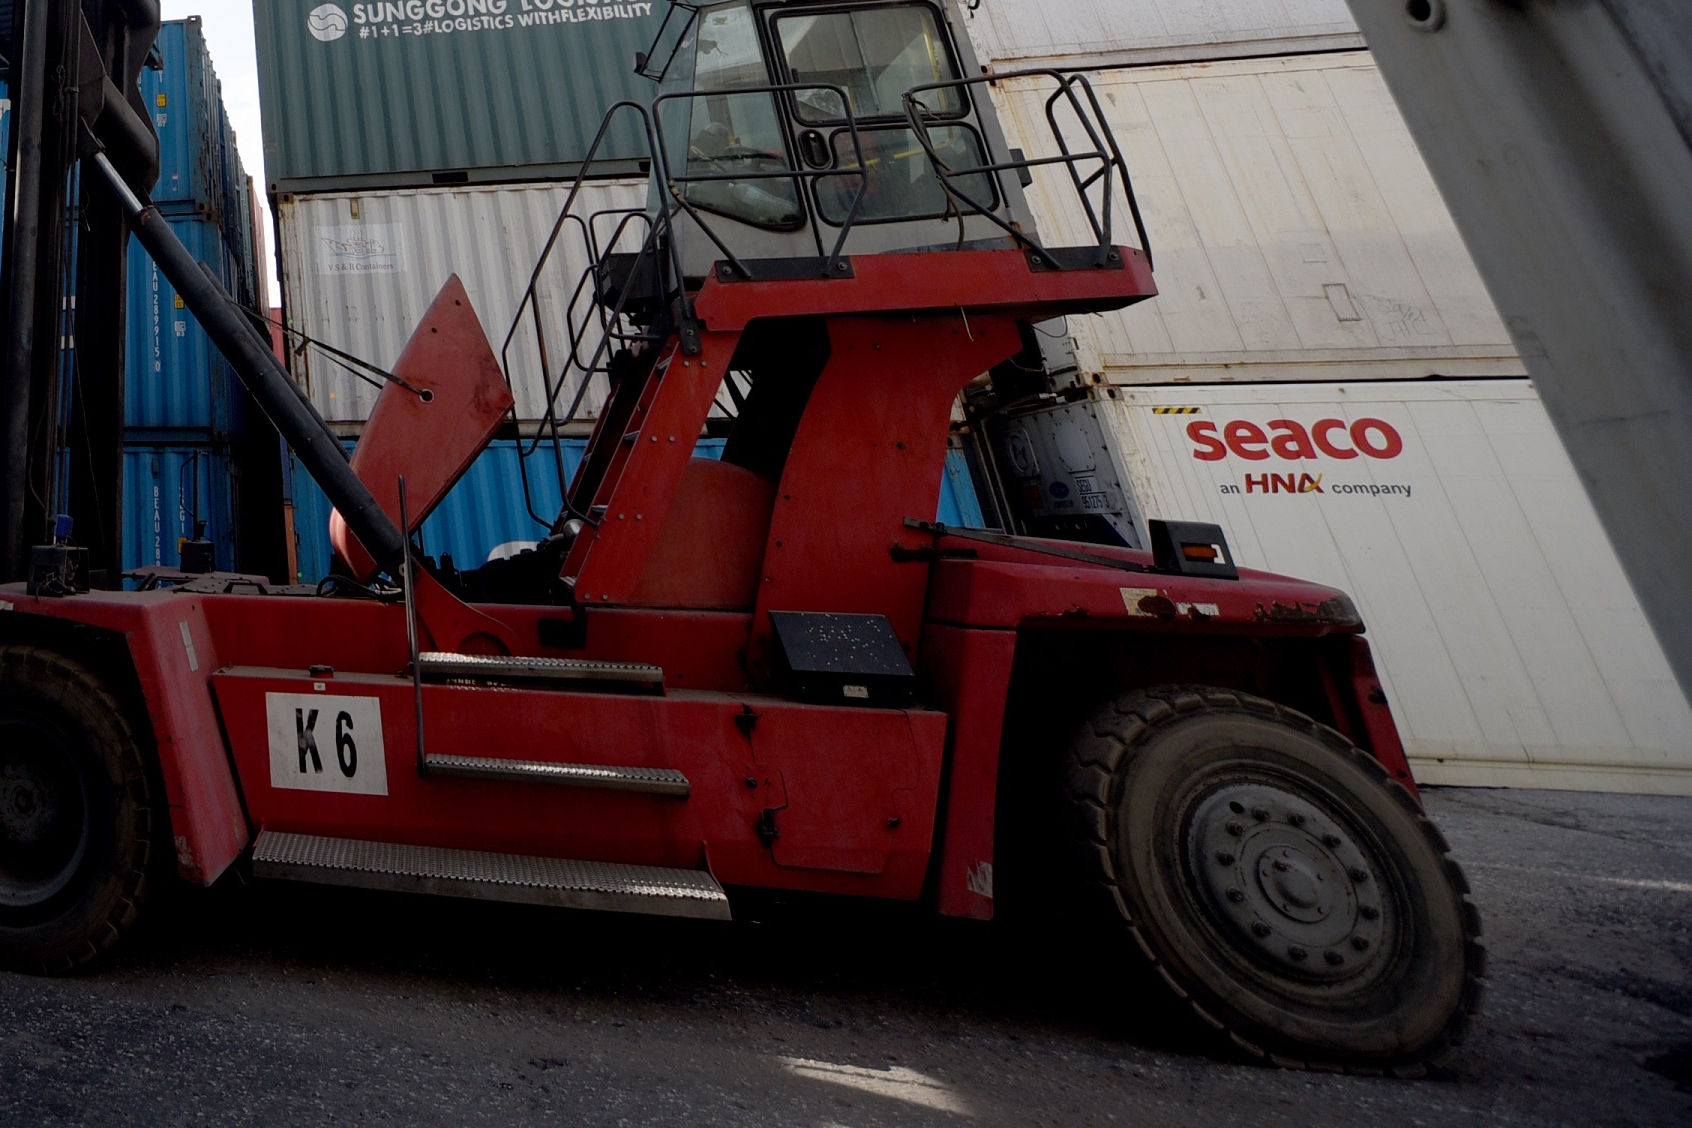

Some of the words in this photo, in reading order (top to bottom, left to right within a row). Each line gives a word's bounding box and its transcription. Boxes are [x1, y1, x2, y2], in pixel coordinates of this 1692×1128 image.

[359, 14, 514, 39] #1+1=3#LOGISTICS
[355, 261, 394, 271] Containers
[1185, 417, 1403, 462] seaco
[1219, 482, 1240, 495] an
[1244, 472, 1324, 494] HNA
[1331, 481, 1412, 498] company
